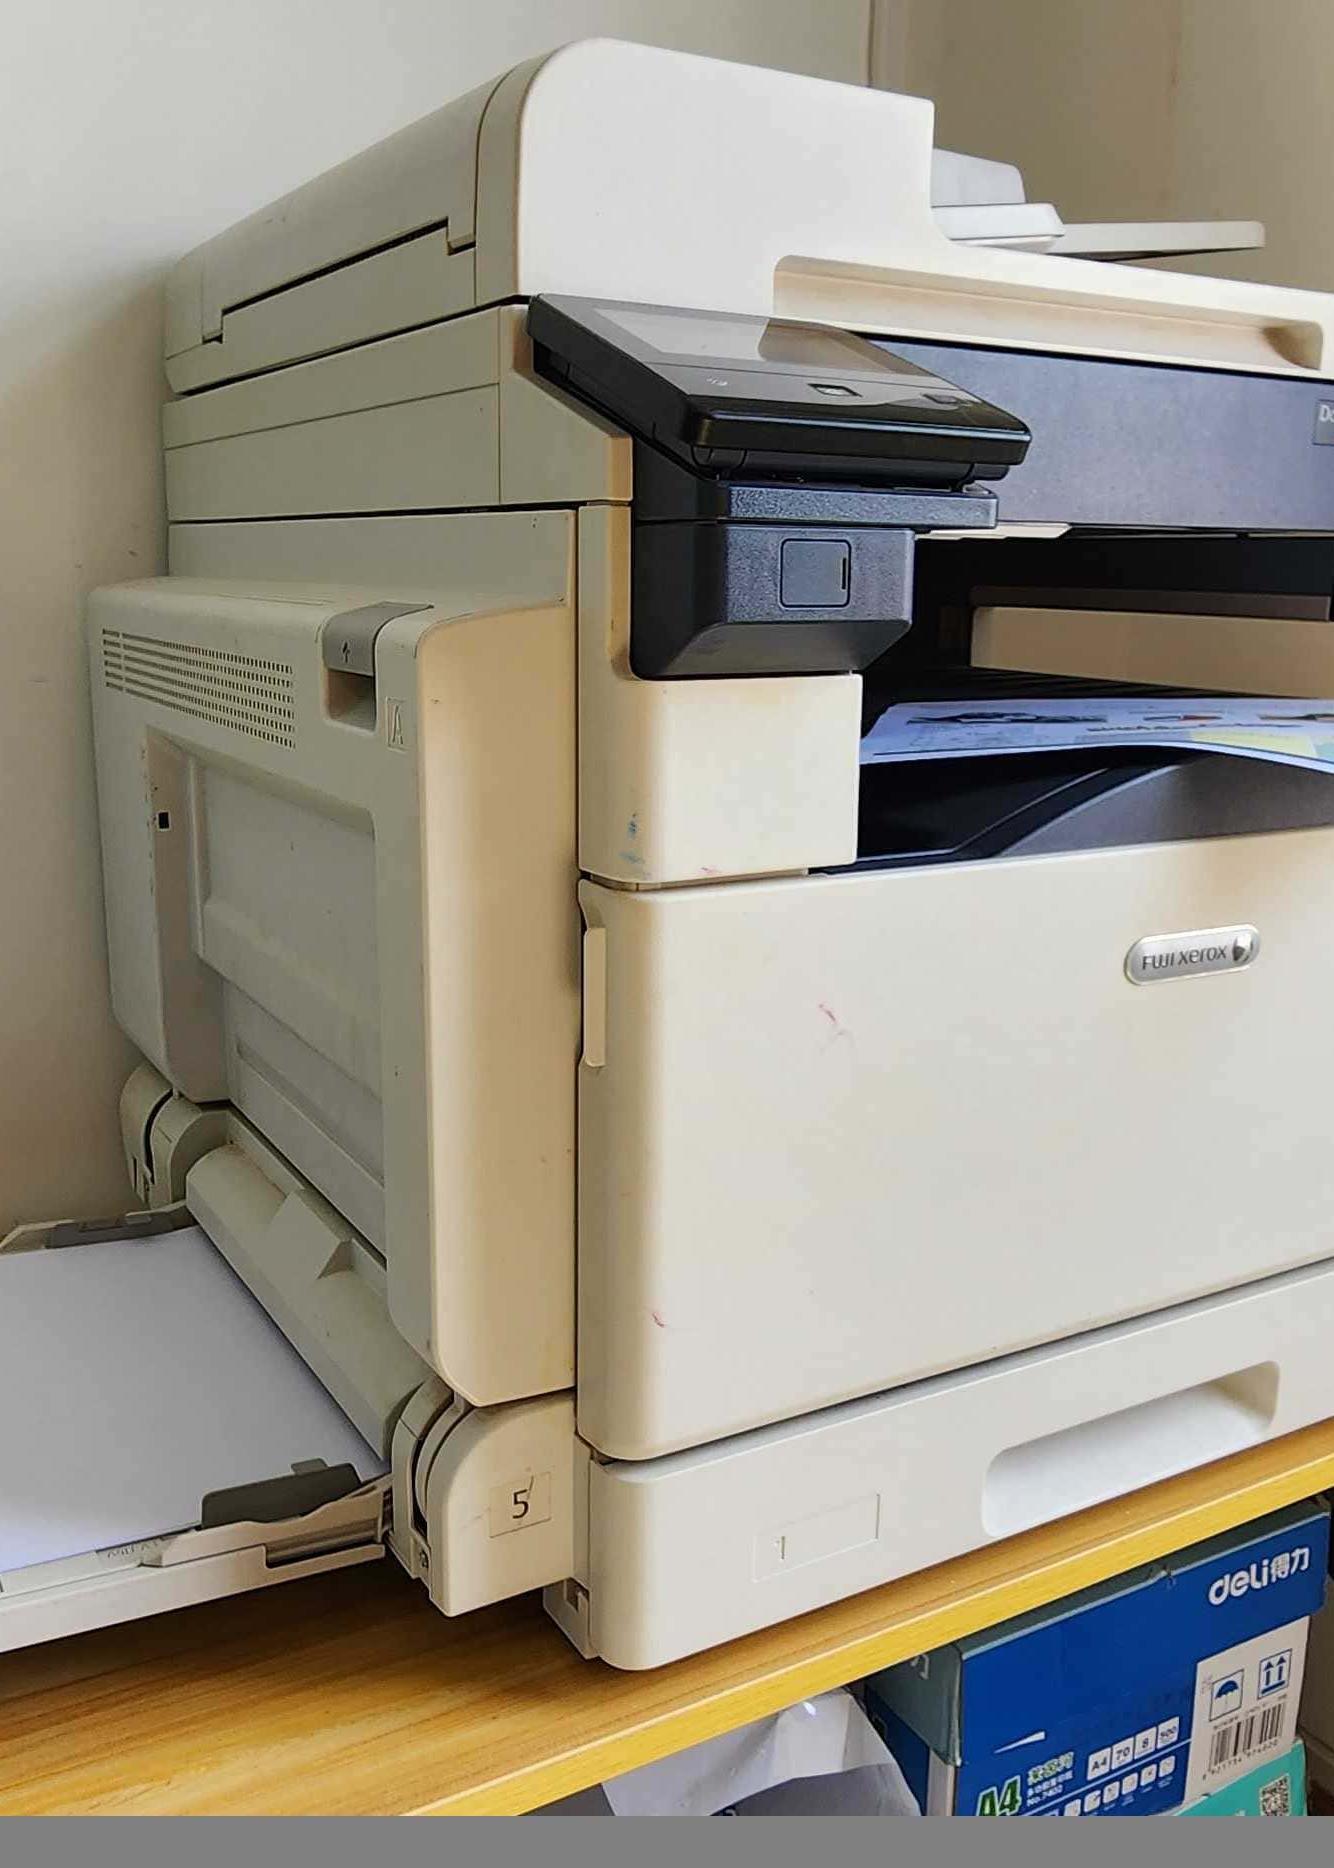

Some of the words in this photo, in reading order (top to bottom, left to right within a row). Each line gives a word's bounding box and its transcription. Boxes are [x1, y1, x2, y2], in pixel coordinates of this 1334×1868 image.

[1141, 952, 1175, 970] FUJI
[1178, 945, 1227, 966] xerox
[512, 1489, 529, 1519] 5
[1091, 1756, 1107, 1771] A4
[1116, 1746, 1131, 1760] 70
[1142, 1738, 1149, 1748] 8
[976, 1774, 1023, 1816] A4
